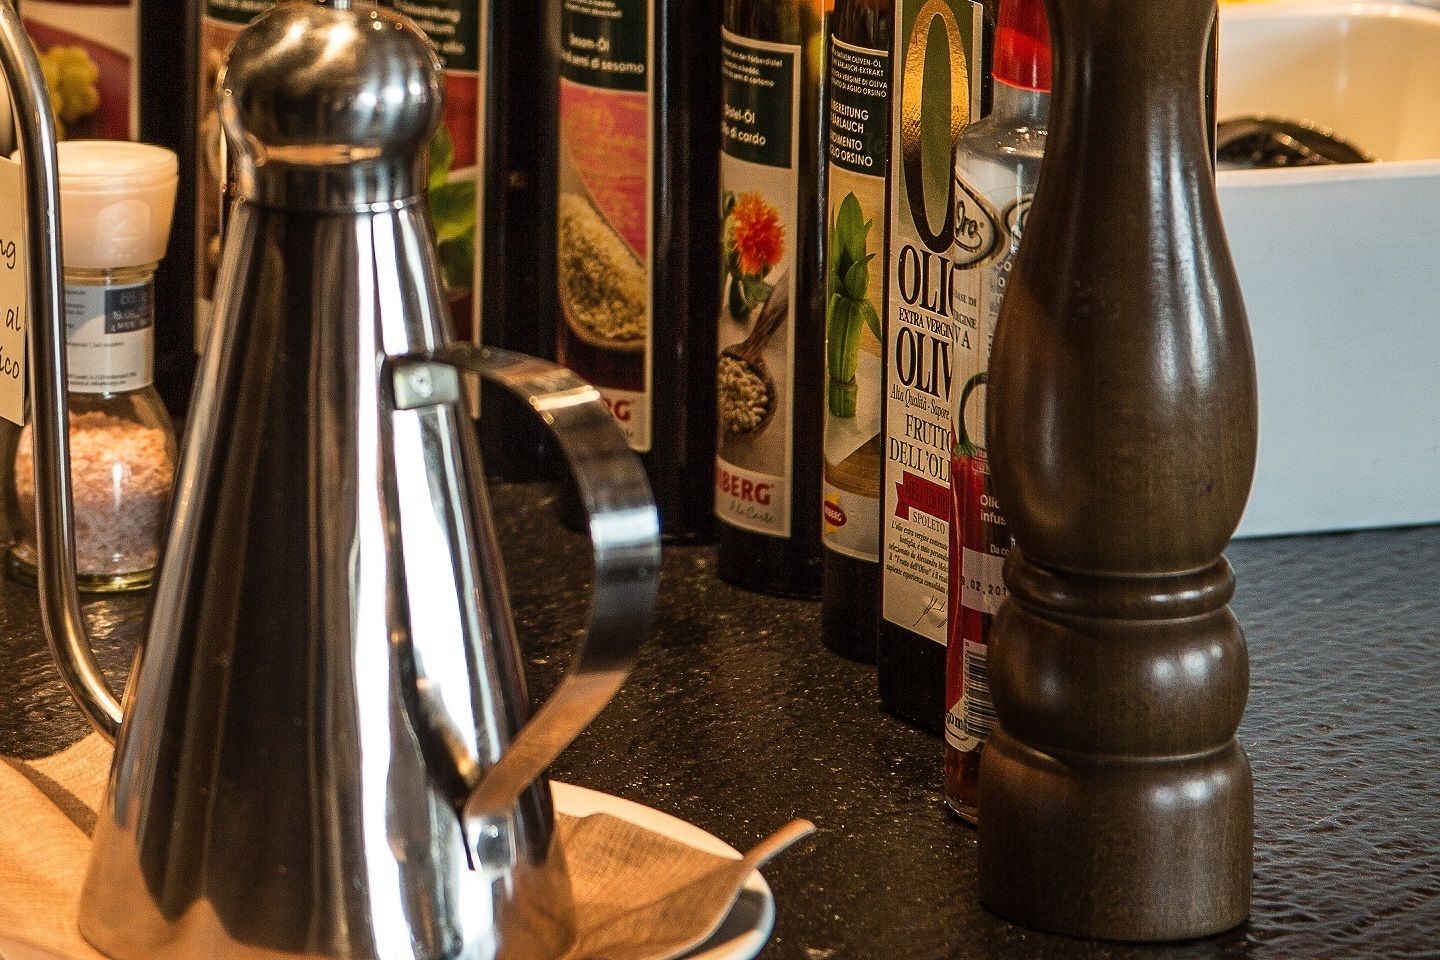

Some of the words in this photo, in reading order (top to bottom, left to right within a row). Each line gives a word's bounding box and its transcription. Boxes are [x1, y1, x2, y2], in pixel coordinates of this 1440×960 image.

[601, 60, 645, 75] sesamo
[851, 56, 882, 68] OLIVEN-ÖL
[846, 84, 862, 94] AGLIO
[862, 88, 887, 98] ORSINO
[868, 80, 888, 90] OLIVA
[738, 130, 767, 147] cardo
[840, 149, 873, 167] ORSINO
[897, 243, 954, 319] OLI
[967, 295, 977, 308] DI
[4, 305, 22, 332] al
[898, 306, 925, 329] EXTRA
[890, 383, 904, 403] Alta
[904, 388, 928, 413] Qualità
[931, 398, 950, 422] Sapore
[912, 511, 946, 536] SPOLETO
